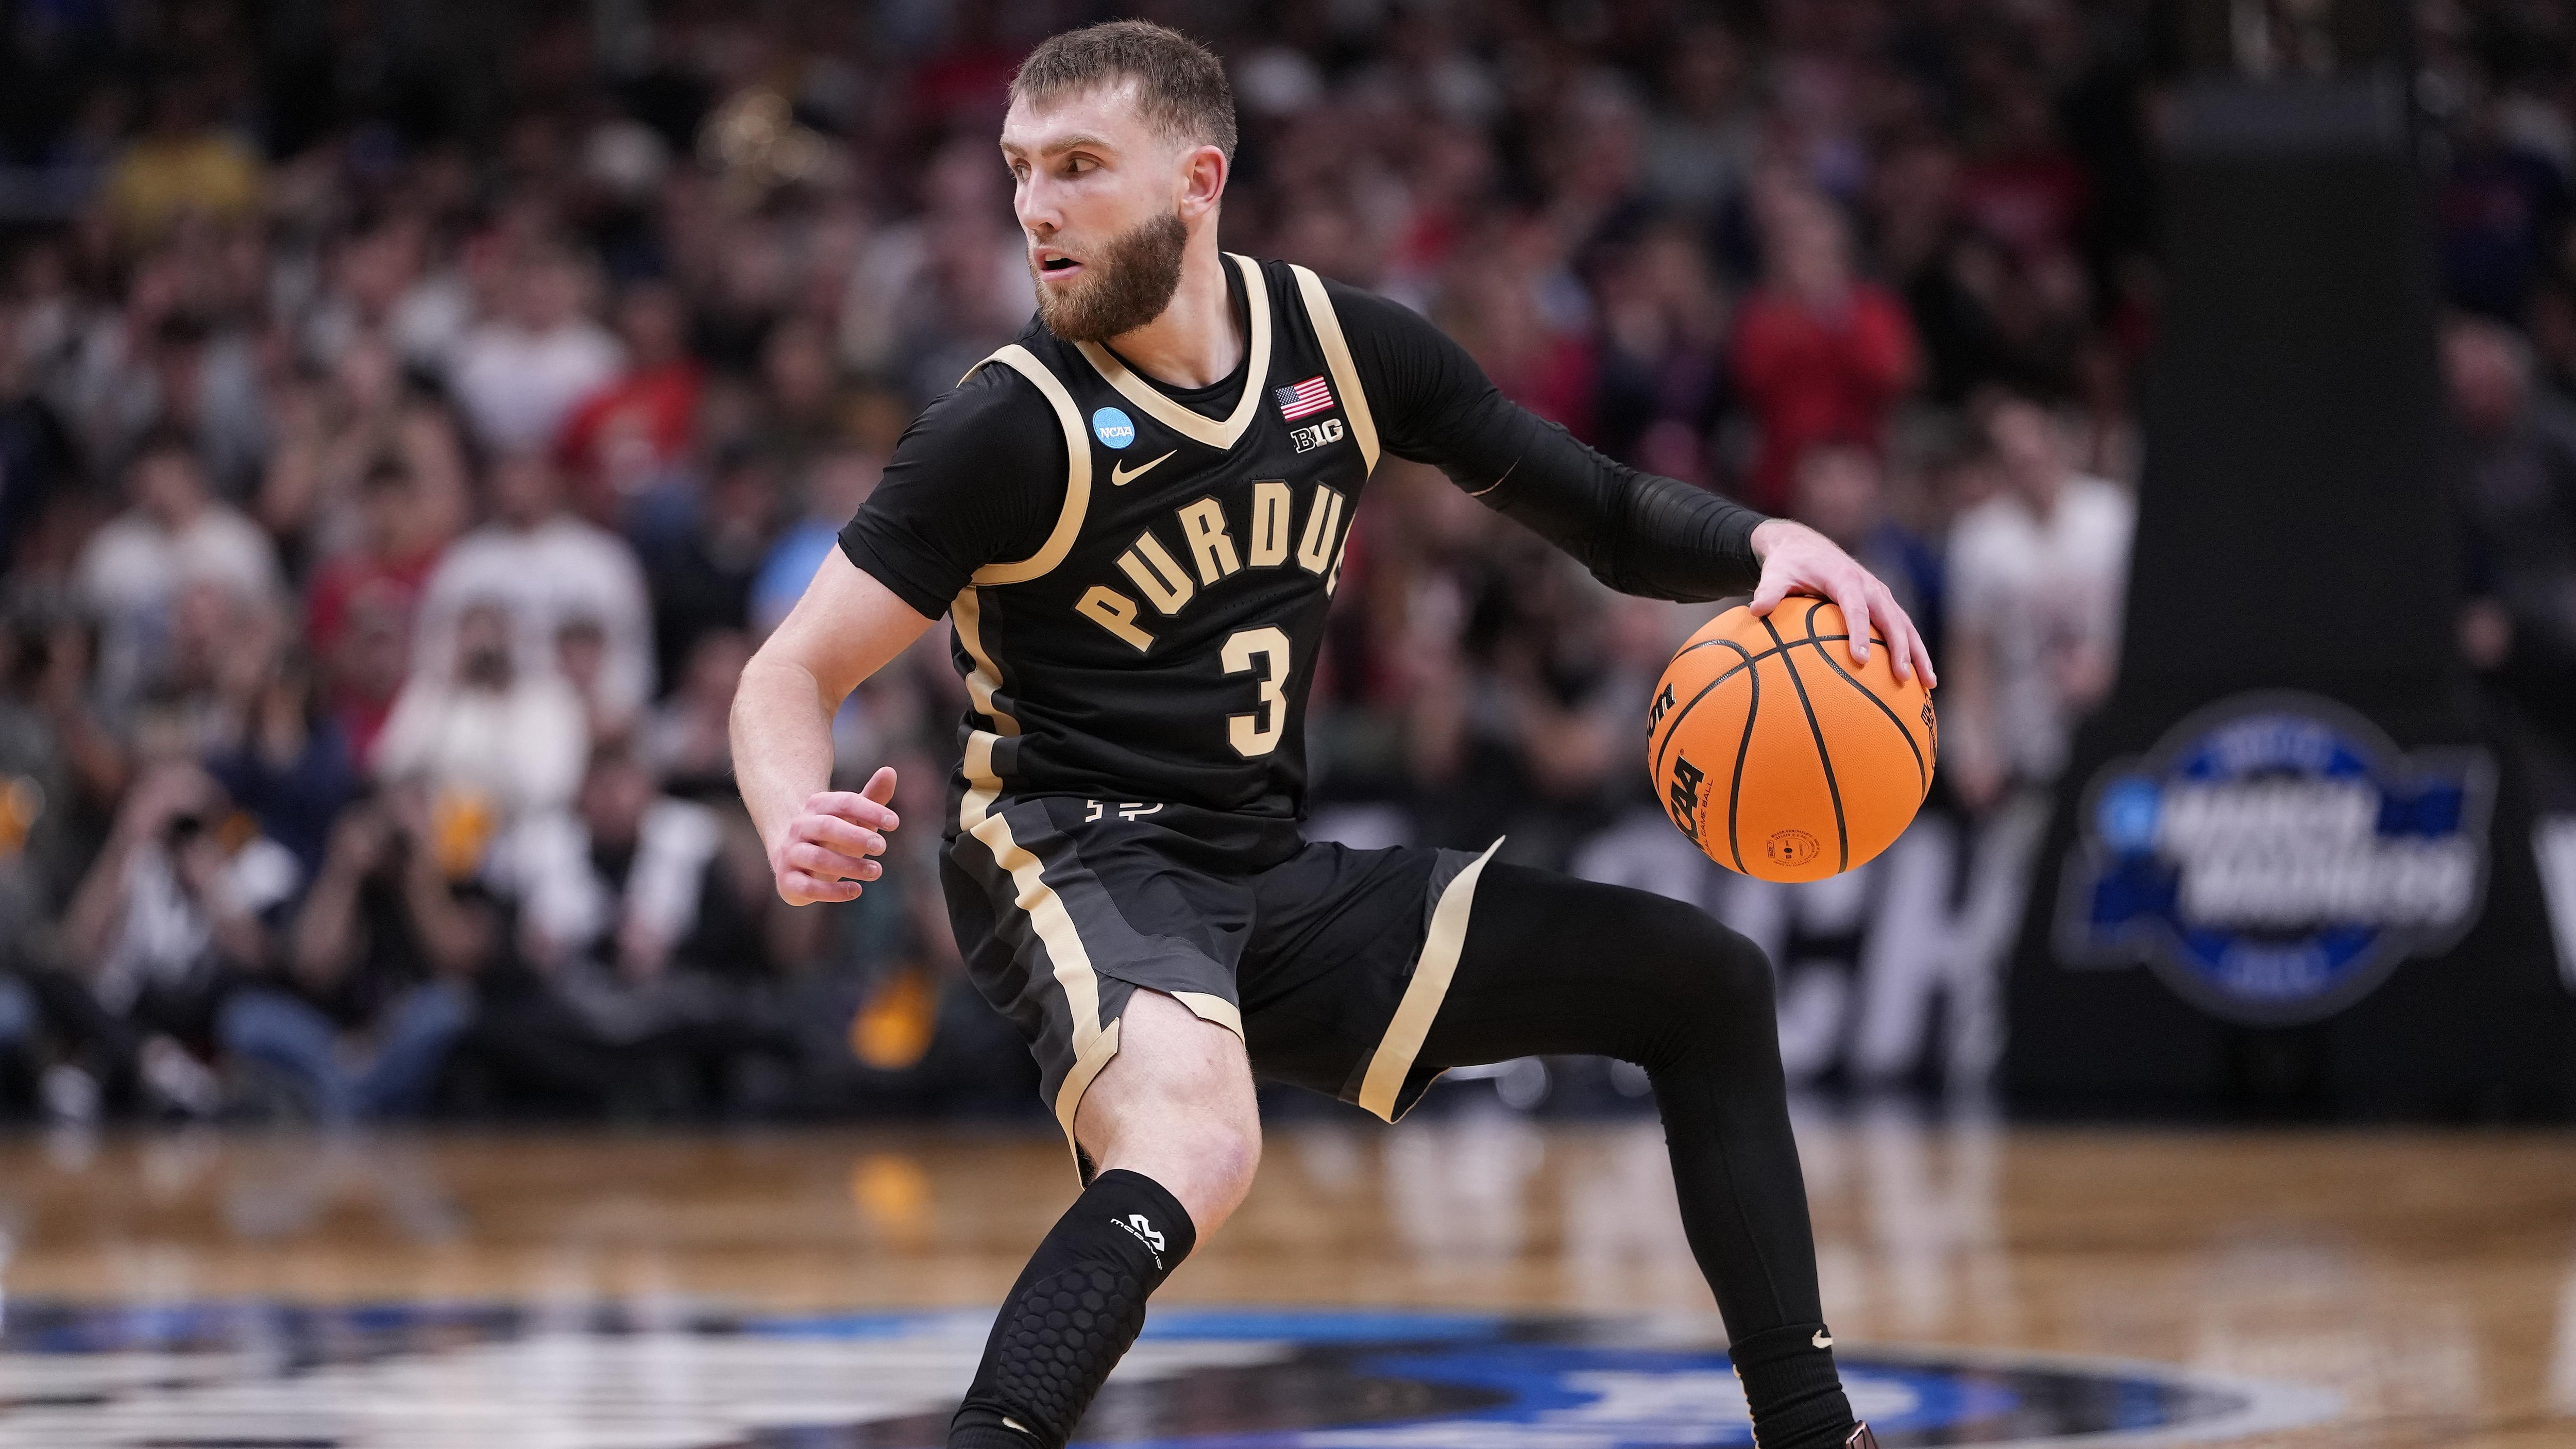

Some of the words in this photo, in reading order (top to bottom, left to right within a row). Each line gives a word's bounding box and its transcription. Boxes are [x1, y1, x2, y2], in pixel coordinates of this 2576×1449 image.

[1099, 426, 1133, 439] NCAA
[1072, 480, 1357, 656] PURDU
[1218, 623, 1292, 760] 3
[1702, 778, 1713, 808] BALL
